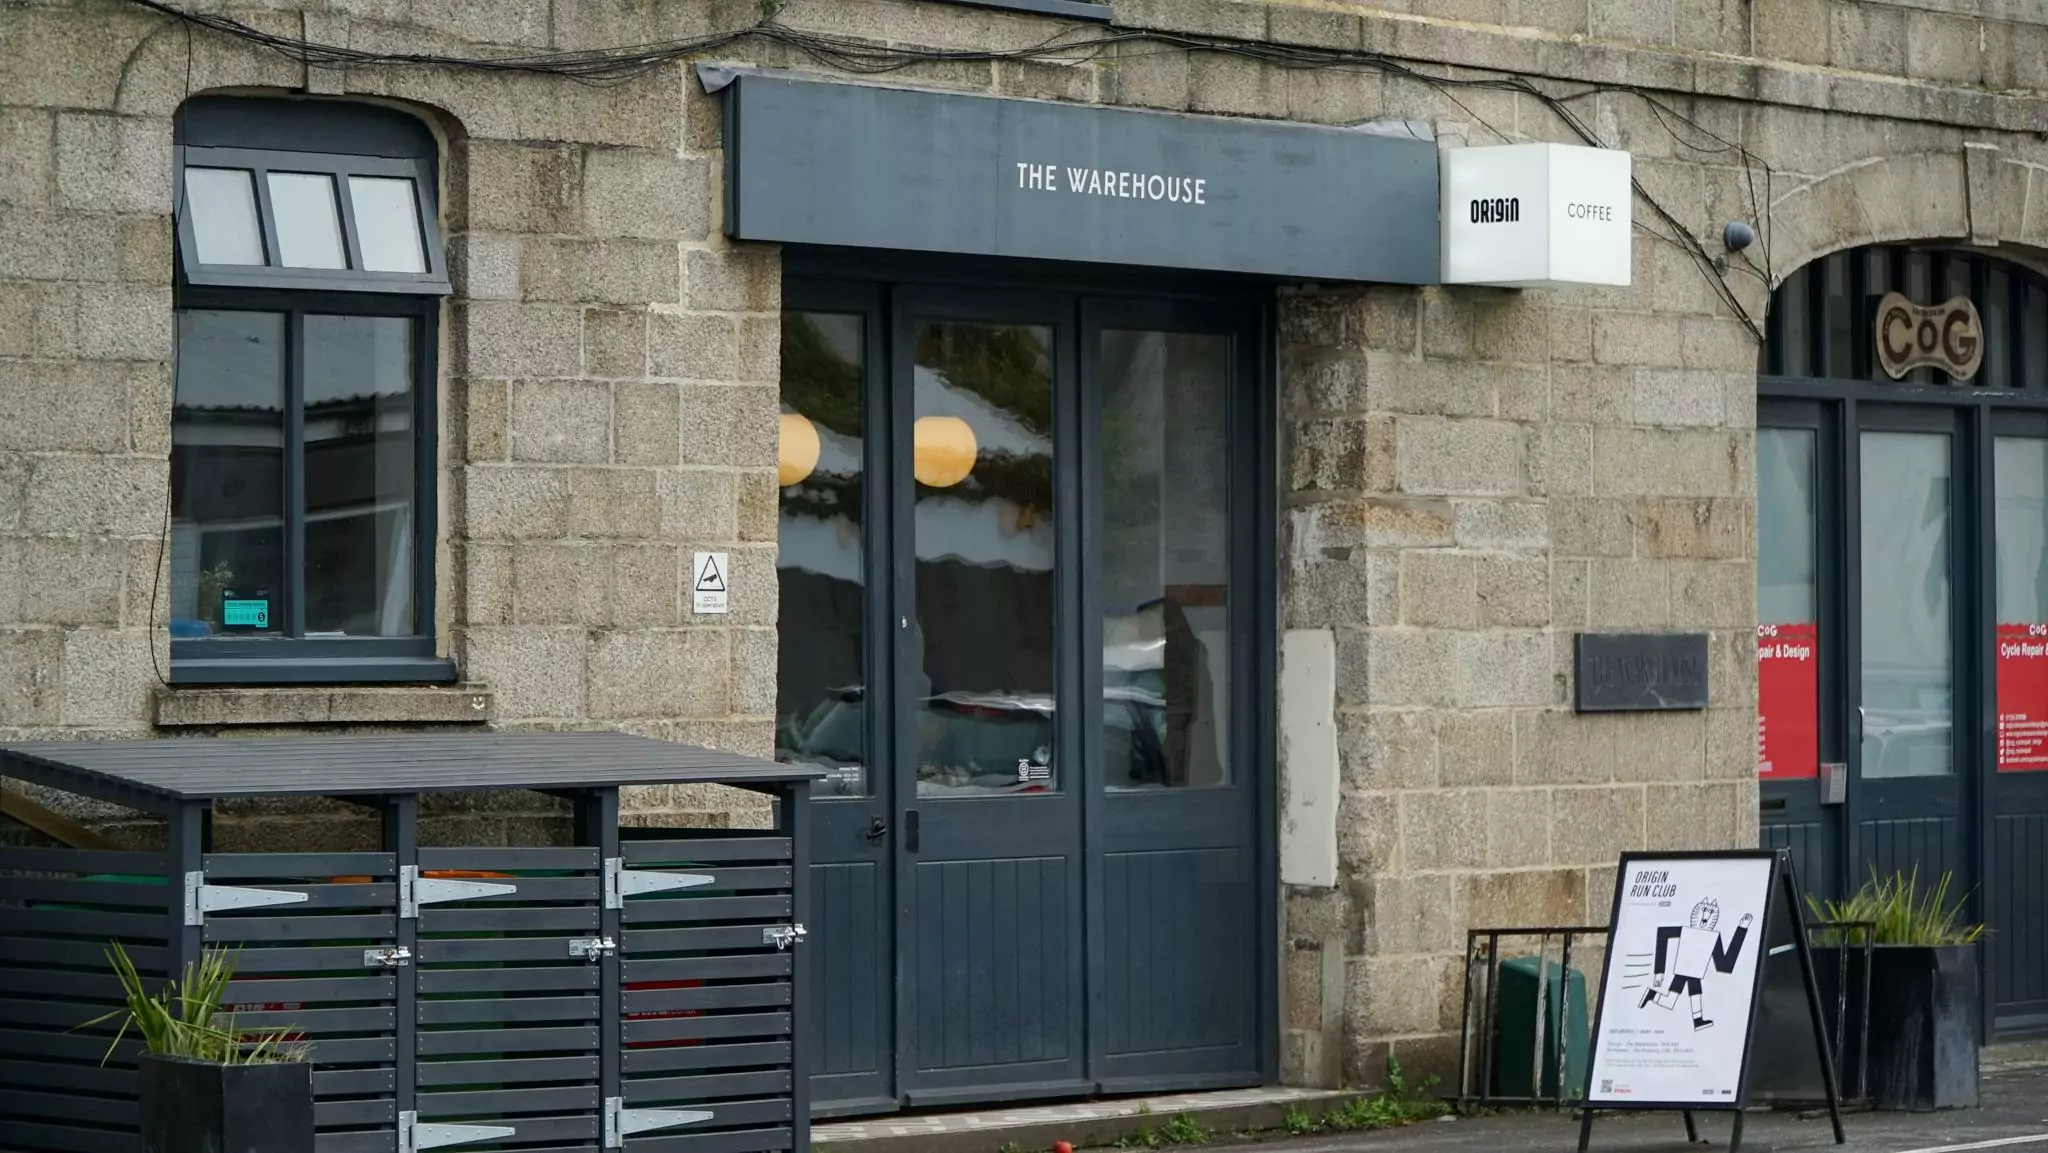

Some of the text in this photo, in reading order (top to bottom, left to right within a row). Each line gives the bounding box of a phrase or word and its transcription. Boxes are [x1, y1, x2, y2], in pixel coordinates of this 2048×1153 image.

[1017, 163, 1206, 205] THE WAREHOUSE
[1567, 203, 1612, 221] COFFEE
[1758, 643, 1810, 662] pair & Design
[2001, 642, 2021, 660] Cycle
[2021, 642, 2044, 660] Repair
[1634, 870, 1670, 884] ORIGIN
[1630, 884, 1677, 898] RUN CLUB
